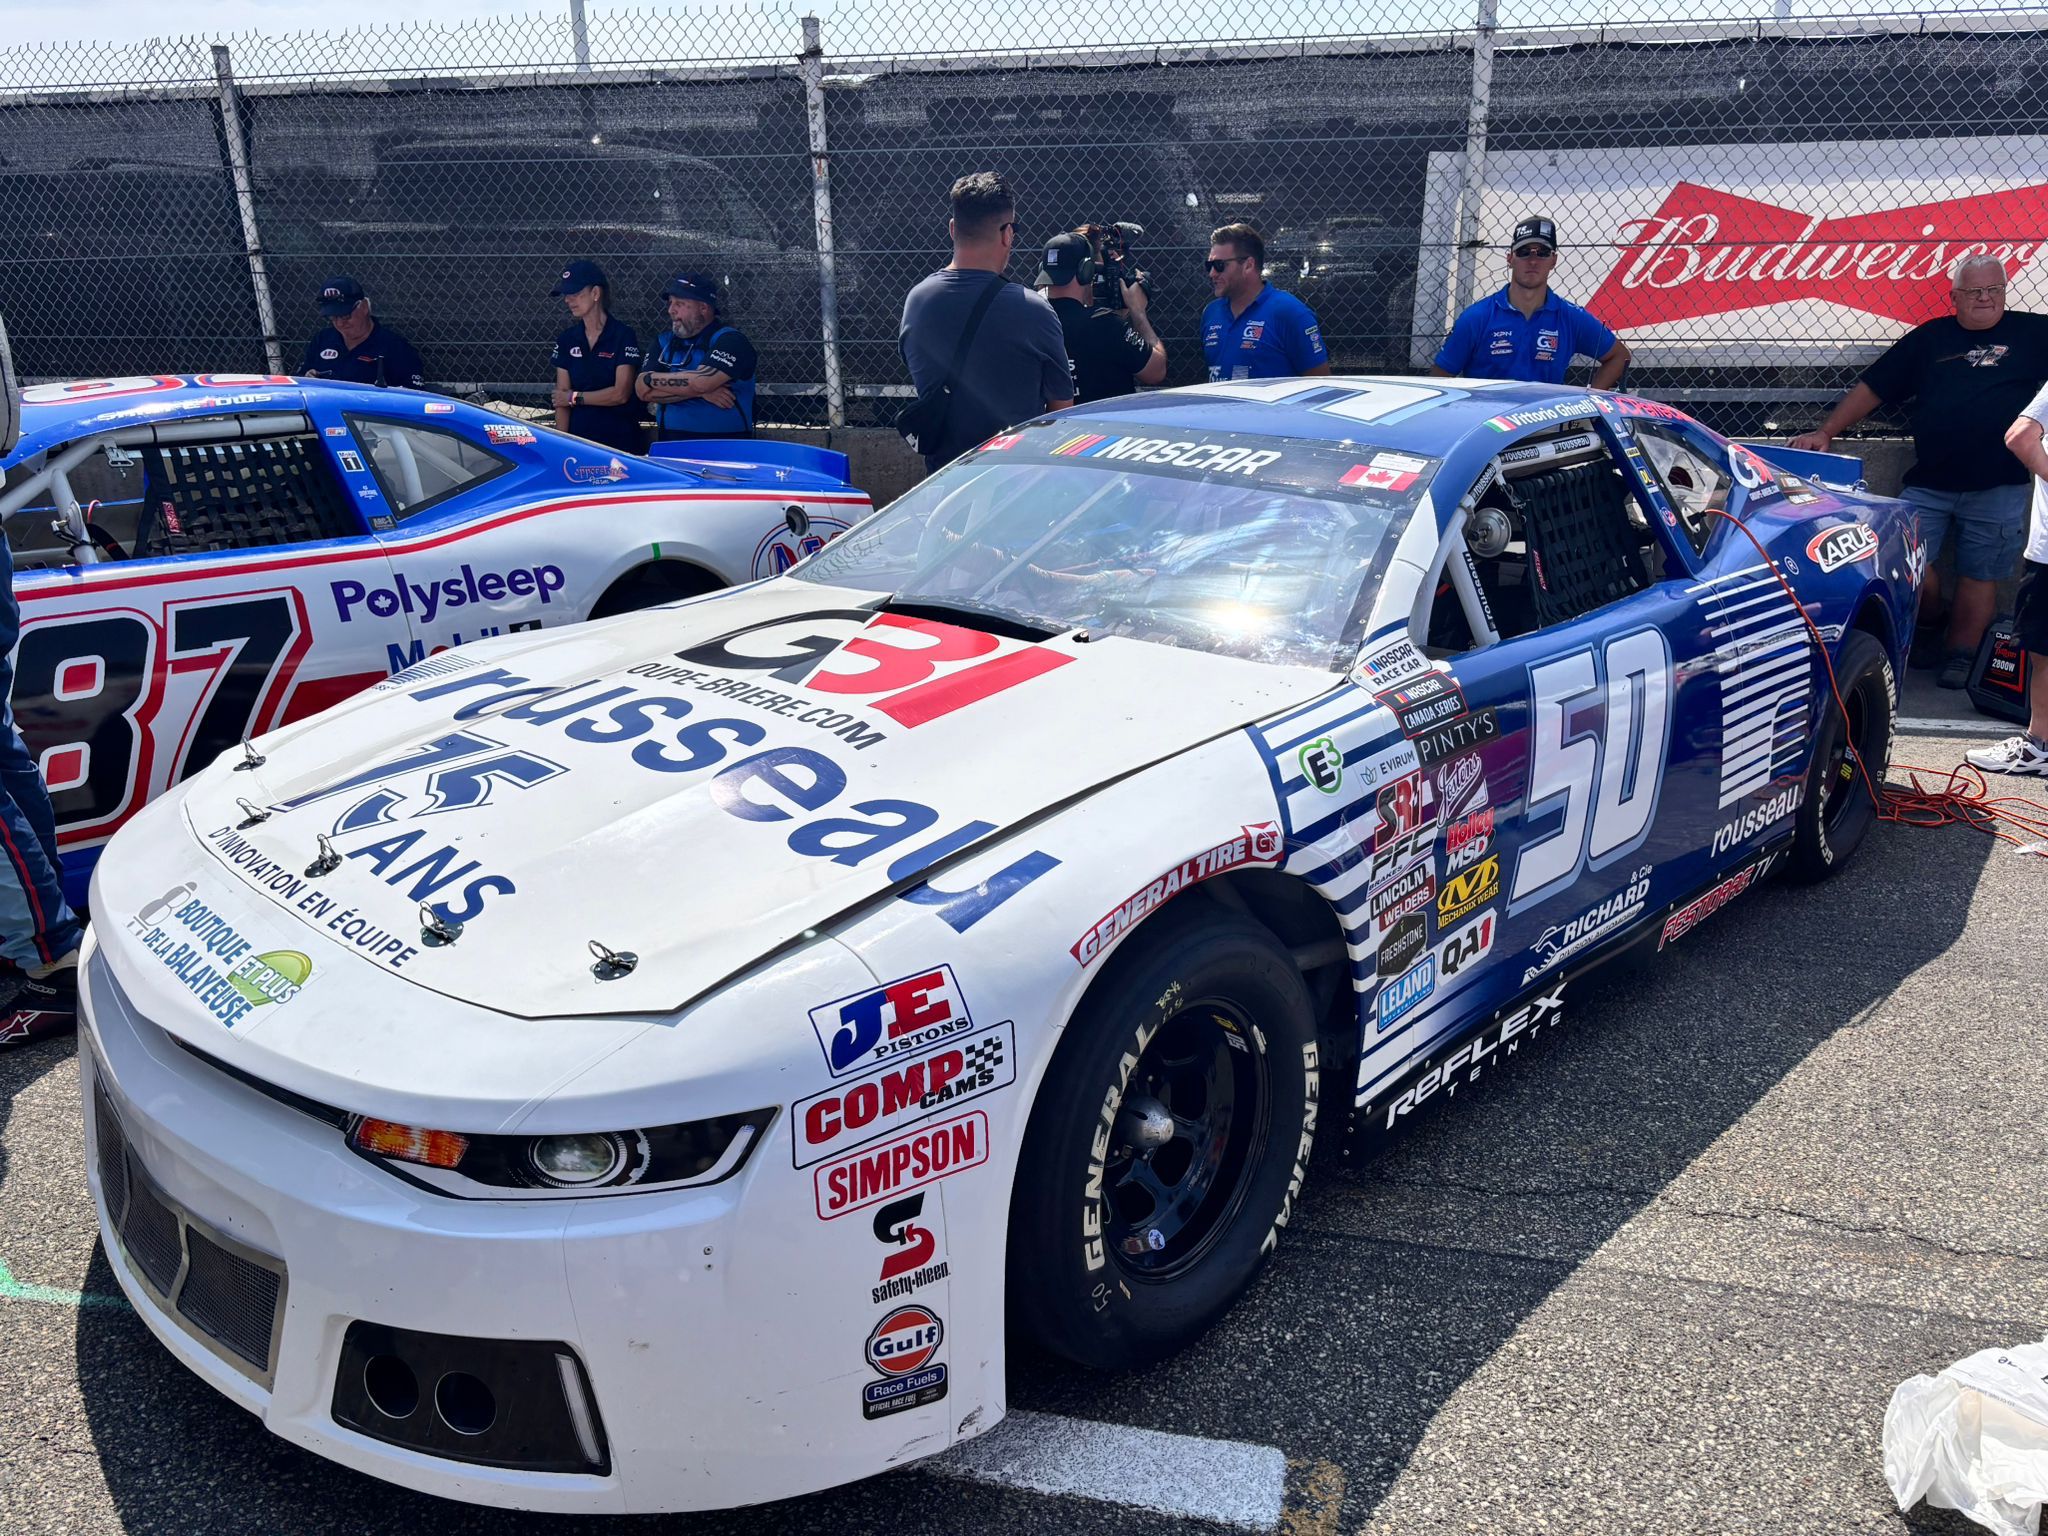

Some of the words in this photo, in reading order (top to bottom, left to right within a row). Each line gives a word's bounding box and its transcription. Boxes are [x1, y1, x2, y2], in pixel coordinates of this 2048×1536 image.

[1506, 405, 1558, 428] Vittorio
[1555, 399, 1598, 419] Ghirelli
[1098, 436, 1282, 476] NASCAR
[1814, 523, 1878, 573] LARUE
[330, 564, 565, 624] Polysleep
[1372, 670, 1401, 687] RACE
[1401, 658, 1423, 674] CAR
[1373, 643, 1416, 672] NASCAR
[1992, 658, 2016, 672] 2800W
[11, 586, 312, 842] 87
[1403, 707, 1437, 730] CANADA
[1436, 696, 1462, 718] SERIES
[1405, 678, 1444, 701] NASCAR
[1380, 750, 1416, 775] EVIRUM
[1420, 712, 1495, 763] PINTY'S
[266, 729, 571, 838] 75
[1506, 624, 1673, 917] 50
[410, 668, 1062, 934] rousseau
[1711, 786, 1800, 859] rousseau
[1370, 821, 1437, 883] PFC
[1447, 807, 1494, 850] Holley
[346, 829, 516, 925] ANS
[1368, 864, 1404, 891] BRAKES
[1446, 835, 1490, 877] MSD
[1630, 871, 1638, 883] &
[1639, 864, 1653, 880] Cie
[208, 826, 308, 900] D'INNOVATION
[297, 891, 335, 920] EN
[327, 908, 419, 969] ÉQUIPE
[1079, 862, 1194, 967] GENERAL
[1196, 837, 1247, 878] TIRE
[1372, 867, 1424, 917] LINCOLN
[1384, 886, 1430, 927] WELDERS
[1438, 902, 1477, 930] MECHANIX
[1477, 882, 1499, 905] WEAR
[1563, 878, 1650, 945] RICHARD
[143, 926, 162, 948] DE
[154, 937, 175, 957] LA
[174, 899, 252, 966] BOUTIQUE
[1380, 923, 1424, 967] FRESHSTONE
[1441, 916, 1492, 975] QA1
[165, 942, 254, 1029] BALAYEUSE
[235, 956, 265, 978] ET
[254, 965, 302, 1005] PLUS
[1382, 961, 1432, 1018] LELAND
[831, 970, 952, 1071] JE
[873, 1016, 969, 1059] PISTONS
[1448, 1011, 1561, 1098] TEINTE
[805, 1049, 964, 1145] COMP
[920, 1068, 995, 1110] CAMS
[828, 1120, 975, 1211] SIMPSON
[1084, 1022, 1158, 1272] GENERAL
[1260, 1040, 1320, 1257] GENERAL
[873, 1325, 937, 1358] Gulf
[869, 1401, 890, 1414] OFFICIAL
[892, 1396, 905, 1407] RACE
[905, 1393, 917, 1404] FUEL
[873, 1382, 904, 1398] Race
[907, 1372, 937, 1390] Fuels
